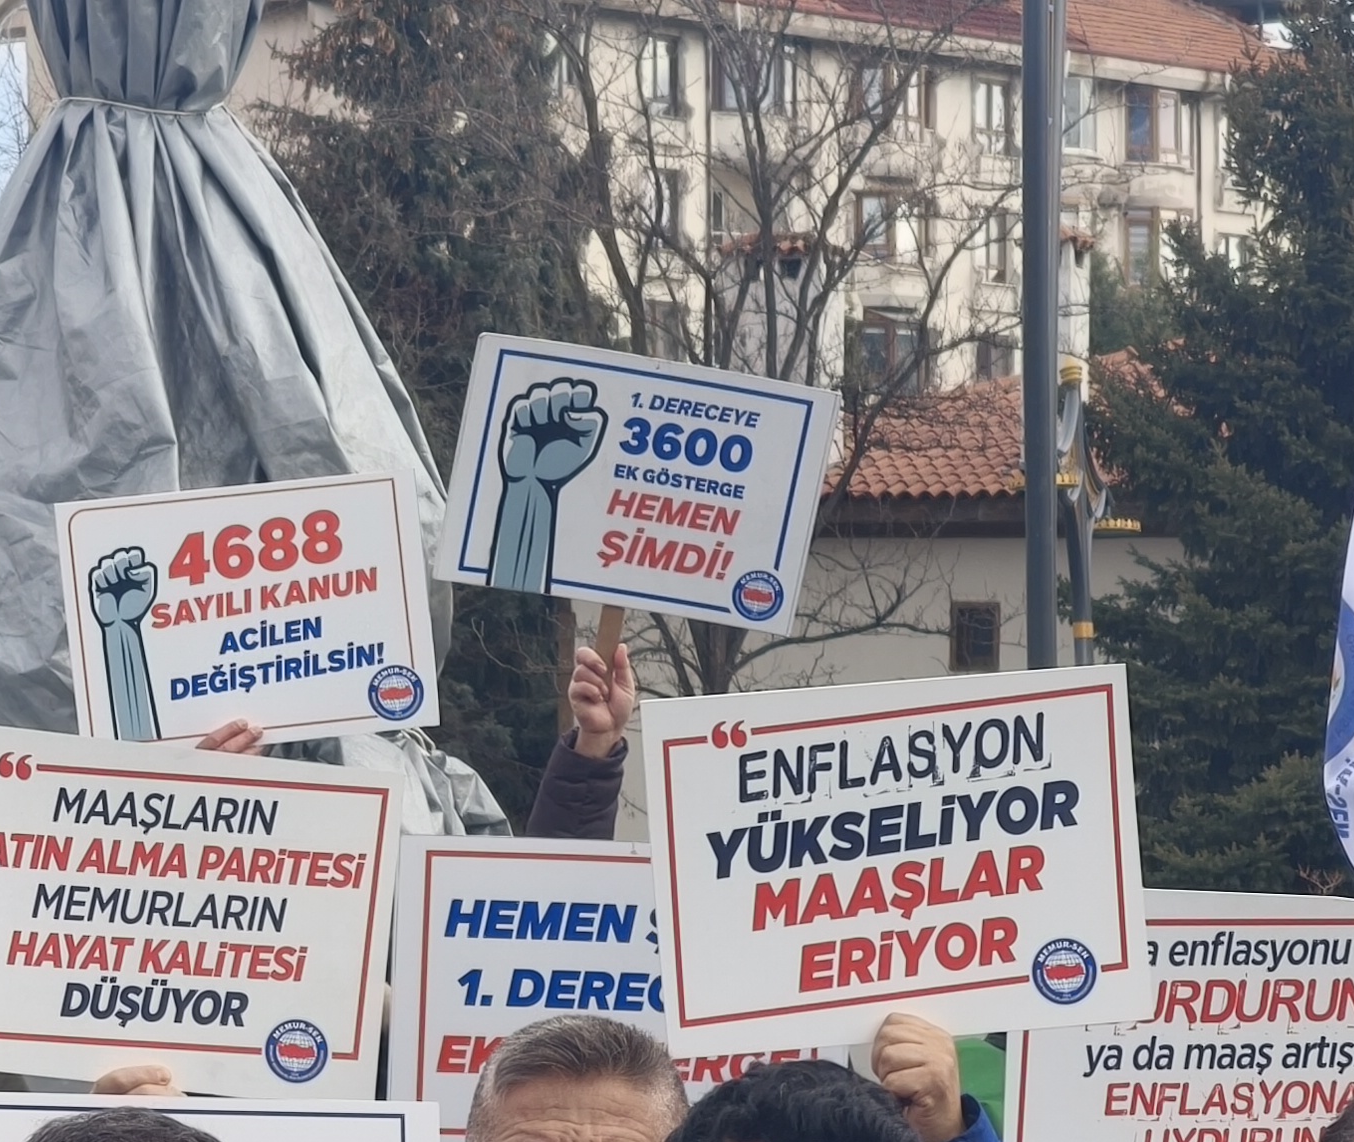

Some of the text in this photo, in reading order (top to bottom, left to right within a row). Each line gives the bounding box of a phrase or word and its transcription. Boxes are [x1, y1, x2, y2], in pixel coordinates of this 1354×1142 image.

[630, 391, 761, 429] 1. DERECEYE
[618, 416, 754, 473] 3600
[613, 463, 746, 500] EK GÖSTERGE
[606, 488, 741, 537] HEMEN
[168, 509, 344, 587] 4688
[596, 526, 735, 580] ŞİMDİ!
[151, 566, 378, 629] SAYILI KANUN
[219, 615, 323, 656] ACİLEN
[170, 641, 386, 703] DEĞİŞTİRİLSİN!
[739, 711, 1049, 804] ENFLASYON
[52, 786, 280, 835] MAAŞLARIN
[706, 779, 1080, 880] YÜKSELİYOR
[76, 836, 189, 880] ALMA
[196, 844, 368, 890] PARİTESİ
[752, 844, 1046, 932] MAAŞLAR
[31, 883, 288, 933] MEMURLARIN
[444, 899, 638, 944] HEMEN
[6, 930, 308, 983] HAYAT KALİTESİ
[799, 915, 1019, 993] ERİYOR
[1037, 941, 1091, 963] MEMUR-SEN
[1169, 931, 1352, 972] enflasyonu
[59, 976, 250, 1029] DÜŞÜYOR
[457, 968, 493, 1006] 1.
[272, 1021, 324, 1044] MEMUR-SEN
[1082, 1044, 1122, 1078] ya
[1132, 1035, 1175, 1071] da
[1184, 1040, 1273, 1075] maaş
